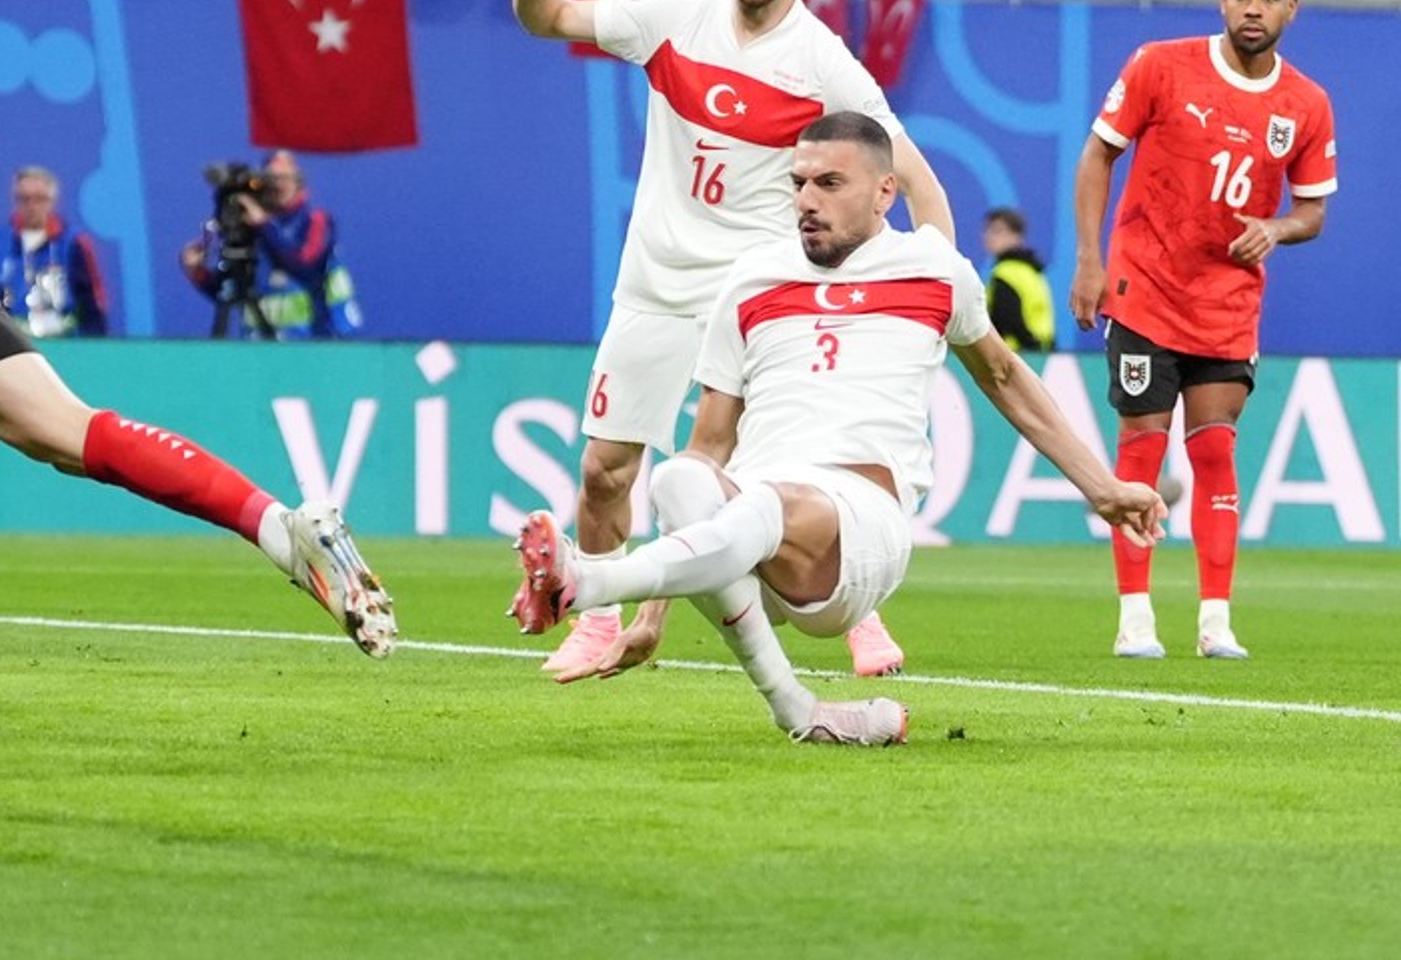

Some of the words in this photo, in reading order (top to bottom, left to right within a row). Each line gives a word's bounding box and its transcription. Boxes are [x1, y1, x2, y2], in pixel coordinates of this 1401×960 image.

[690, 155, 726, 205] 16
[1210, 150, 1254, 208] 16
[811, 333, 840, 372] 3
[272, 341, 653, 537] vis
